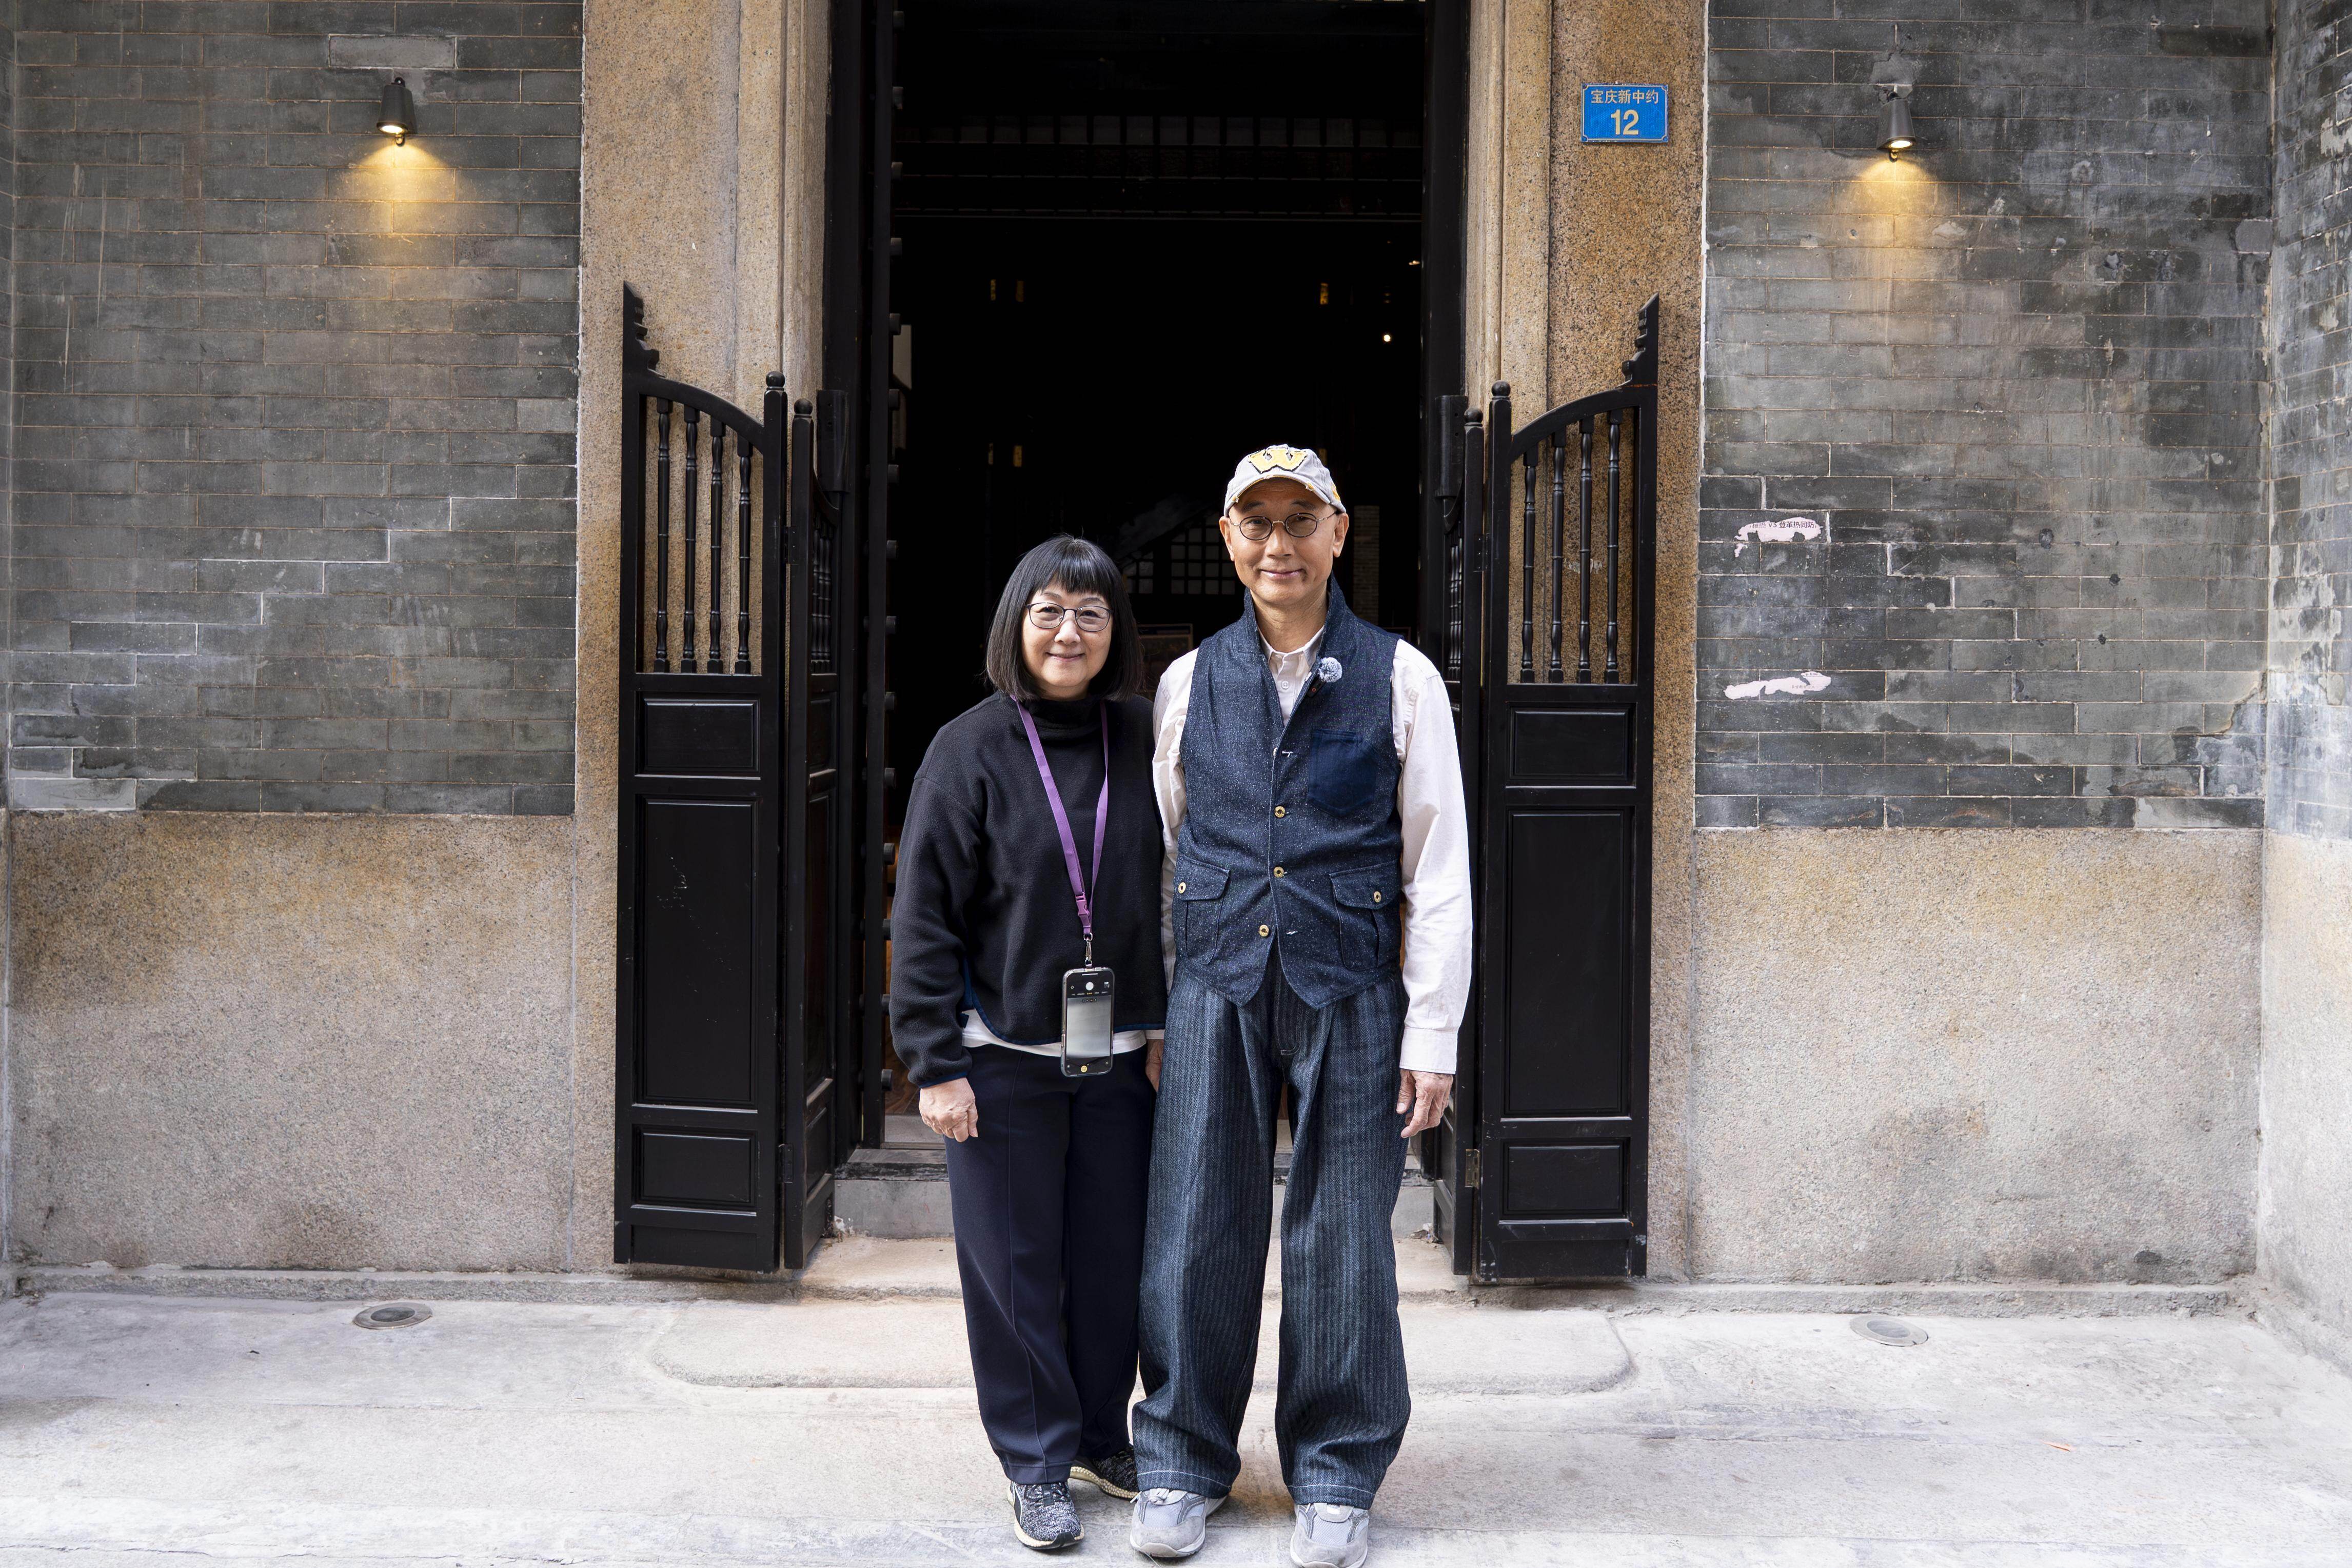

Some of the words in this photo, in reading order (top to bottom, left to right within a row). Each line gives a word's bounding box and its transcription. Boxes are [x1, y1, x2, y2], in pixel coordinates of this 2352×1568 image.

[1591, 90, 1658, 104] 宝庆新中约
[1611, 109, 1639, 135] 12
